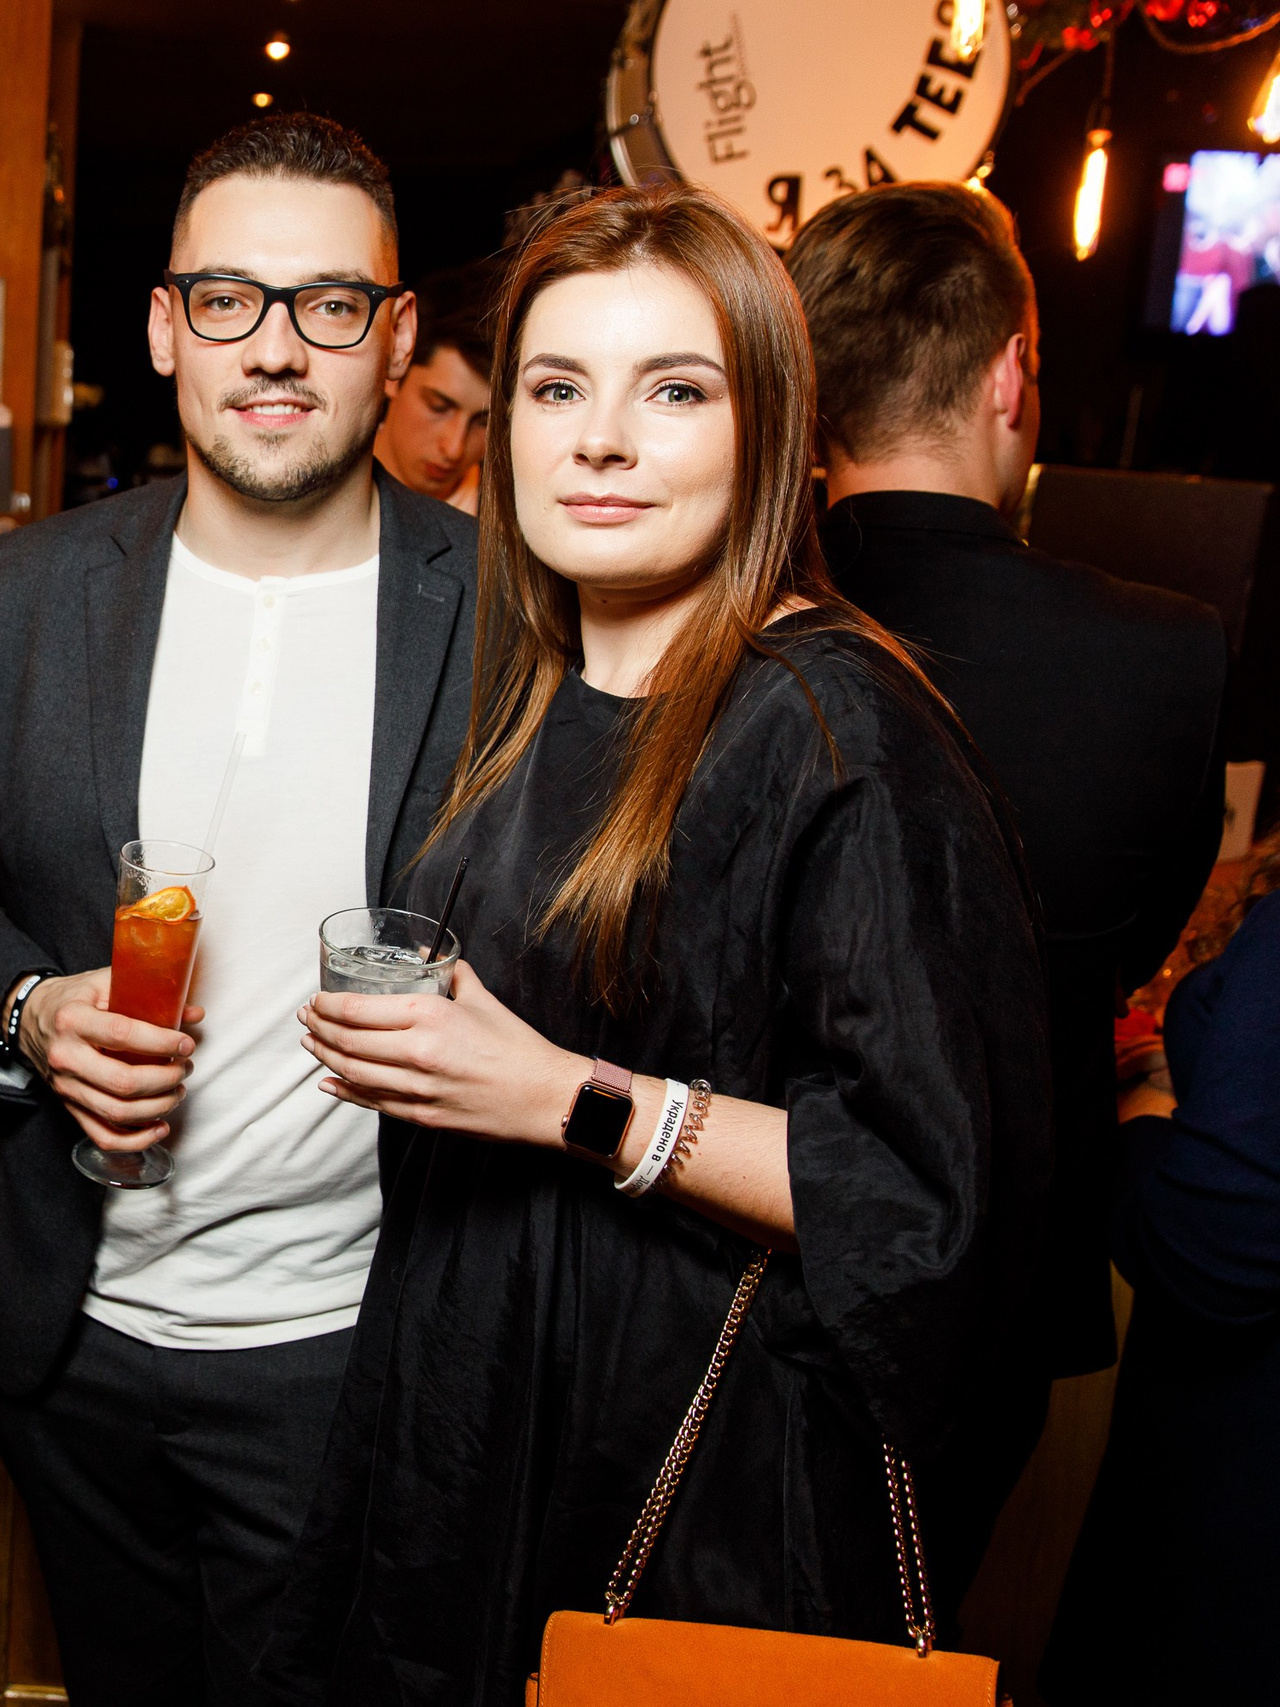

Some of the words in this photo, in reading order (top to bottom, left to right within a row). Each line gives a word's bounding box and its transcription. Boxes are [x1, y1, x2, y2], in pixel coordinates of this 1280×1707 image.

[697, 35, 757, 165] Flight
[768, 174, 802, 233] Я
[656, 1099, 685, 1153] Украдено
